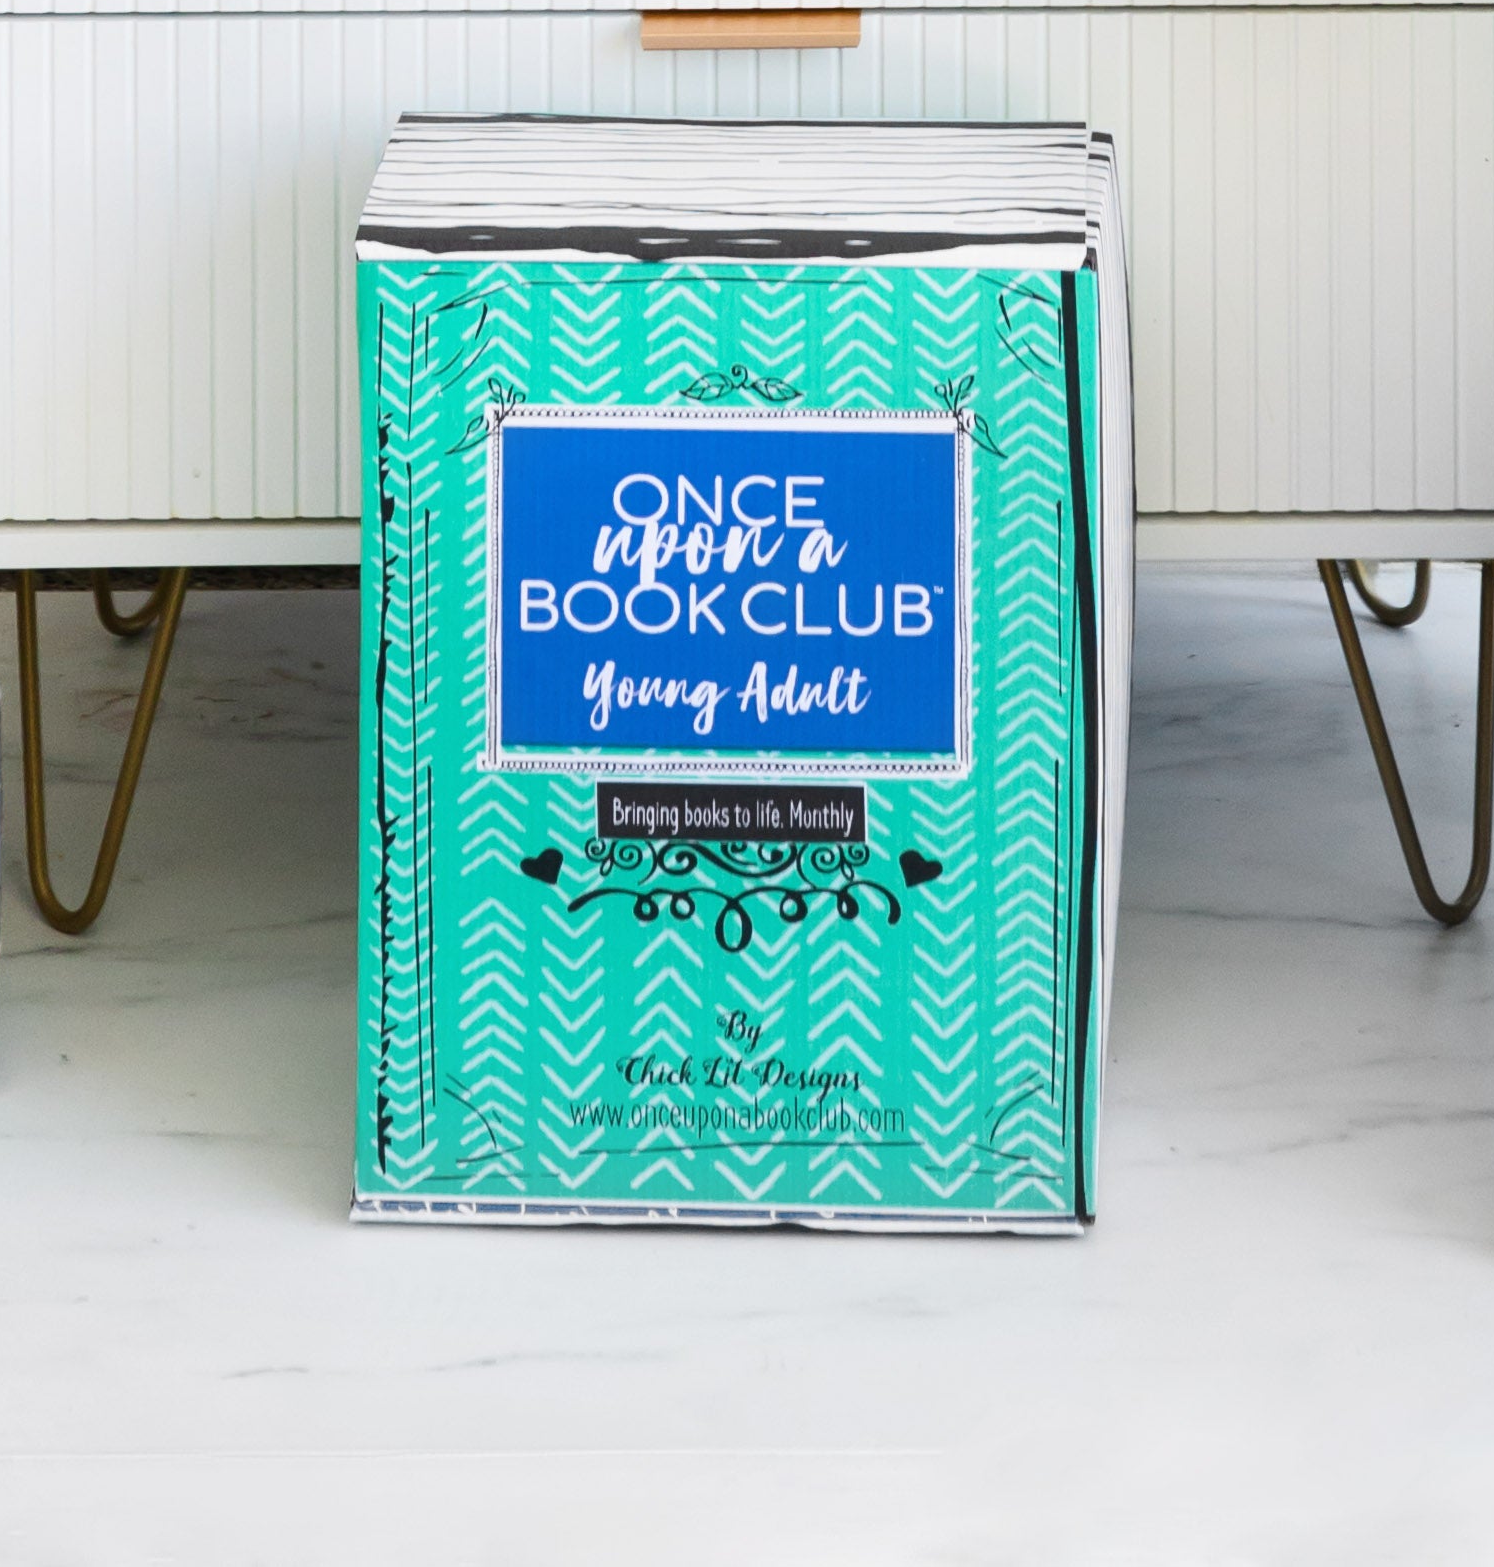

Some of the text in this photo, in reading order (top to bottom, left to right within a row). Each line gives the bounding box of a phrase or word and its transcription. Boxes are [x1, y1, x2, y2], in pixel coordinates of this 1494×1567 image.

[612, 473, 825, 528] ONCE
[593, 520, 849, 591] upon a
[519, 579, 726, 635] BOOK
[582, 660, 872, 736] Young Adult
[612, 797, 854, 837] Bringing books to life. Monthly
[716, 1010, 764, 1054] By
[616, 1054, 865, 1103] Chick Lit Designs
[570, 1097, 905, 1139] www.onceuponabookclub.com
